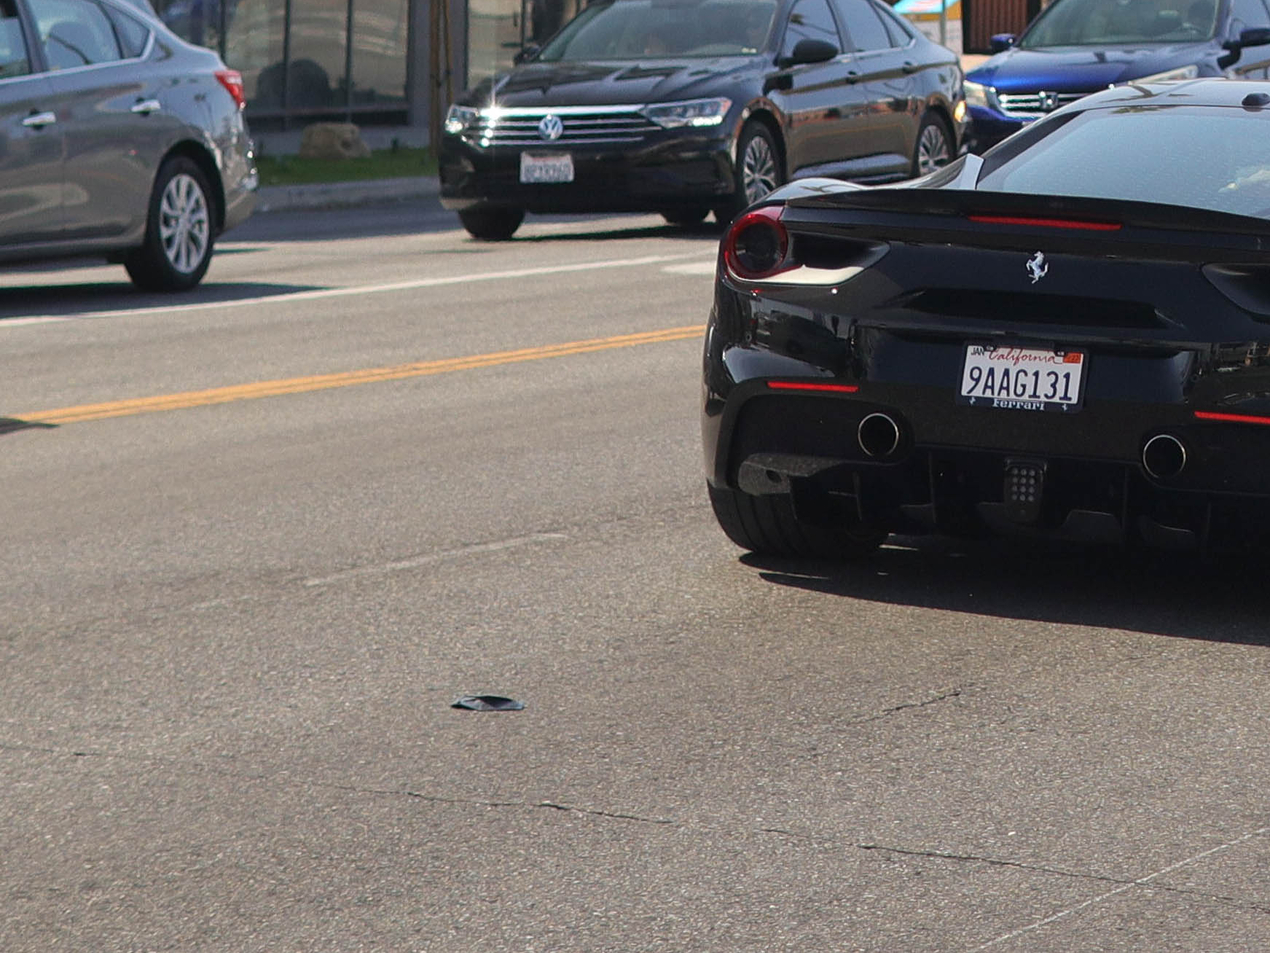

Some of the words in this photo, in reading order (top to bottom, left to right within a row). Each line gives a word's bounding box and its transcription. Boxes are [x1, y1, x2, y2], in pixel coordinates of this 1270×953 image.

[971, 347, 985, 356] JAN
[988, 347, 1062, 366] California
[966, 366, 1072, 401] 9AAG131
[992, 398, 1044, 411] Ferrari
